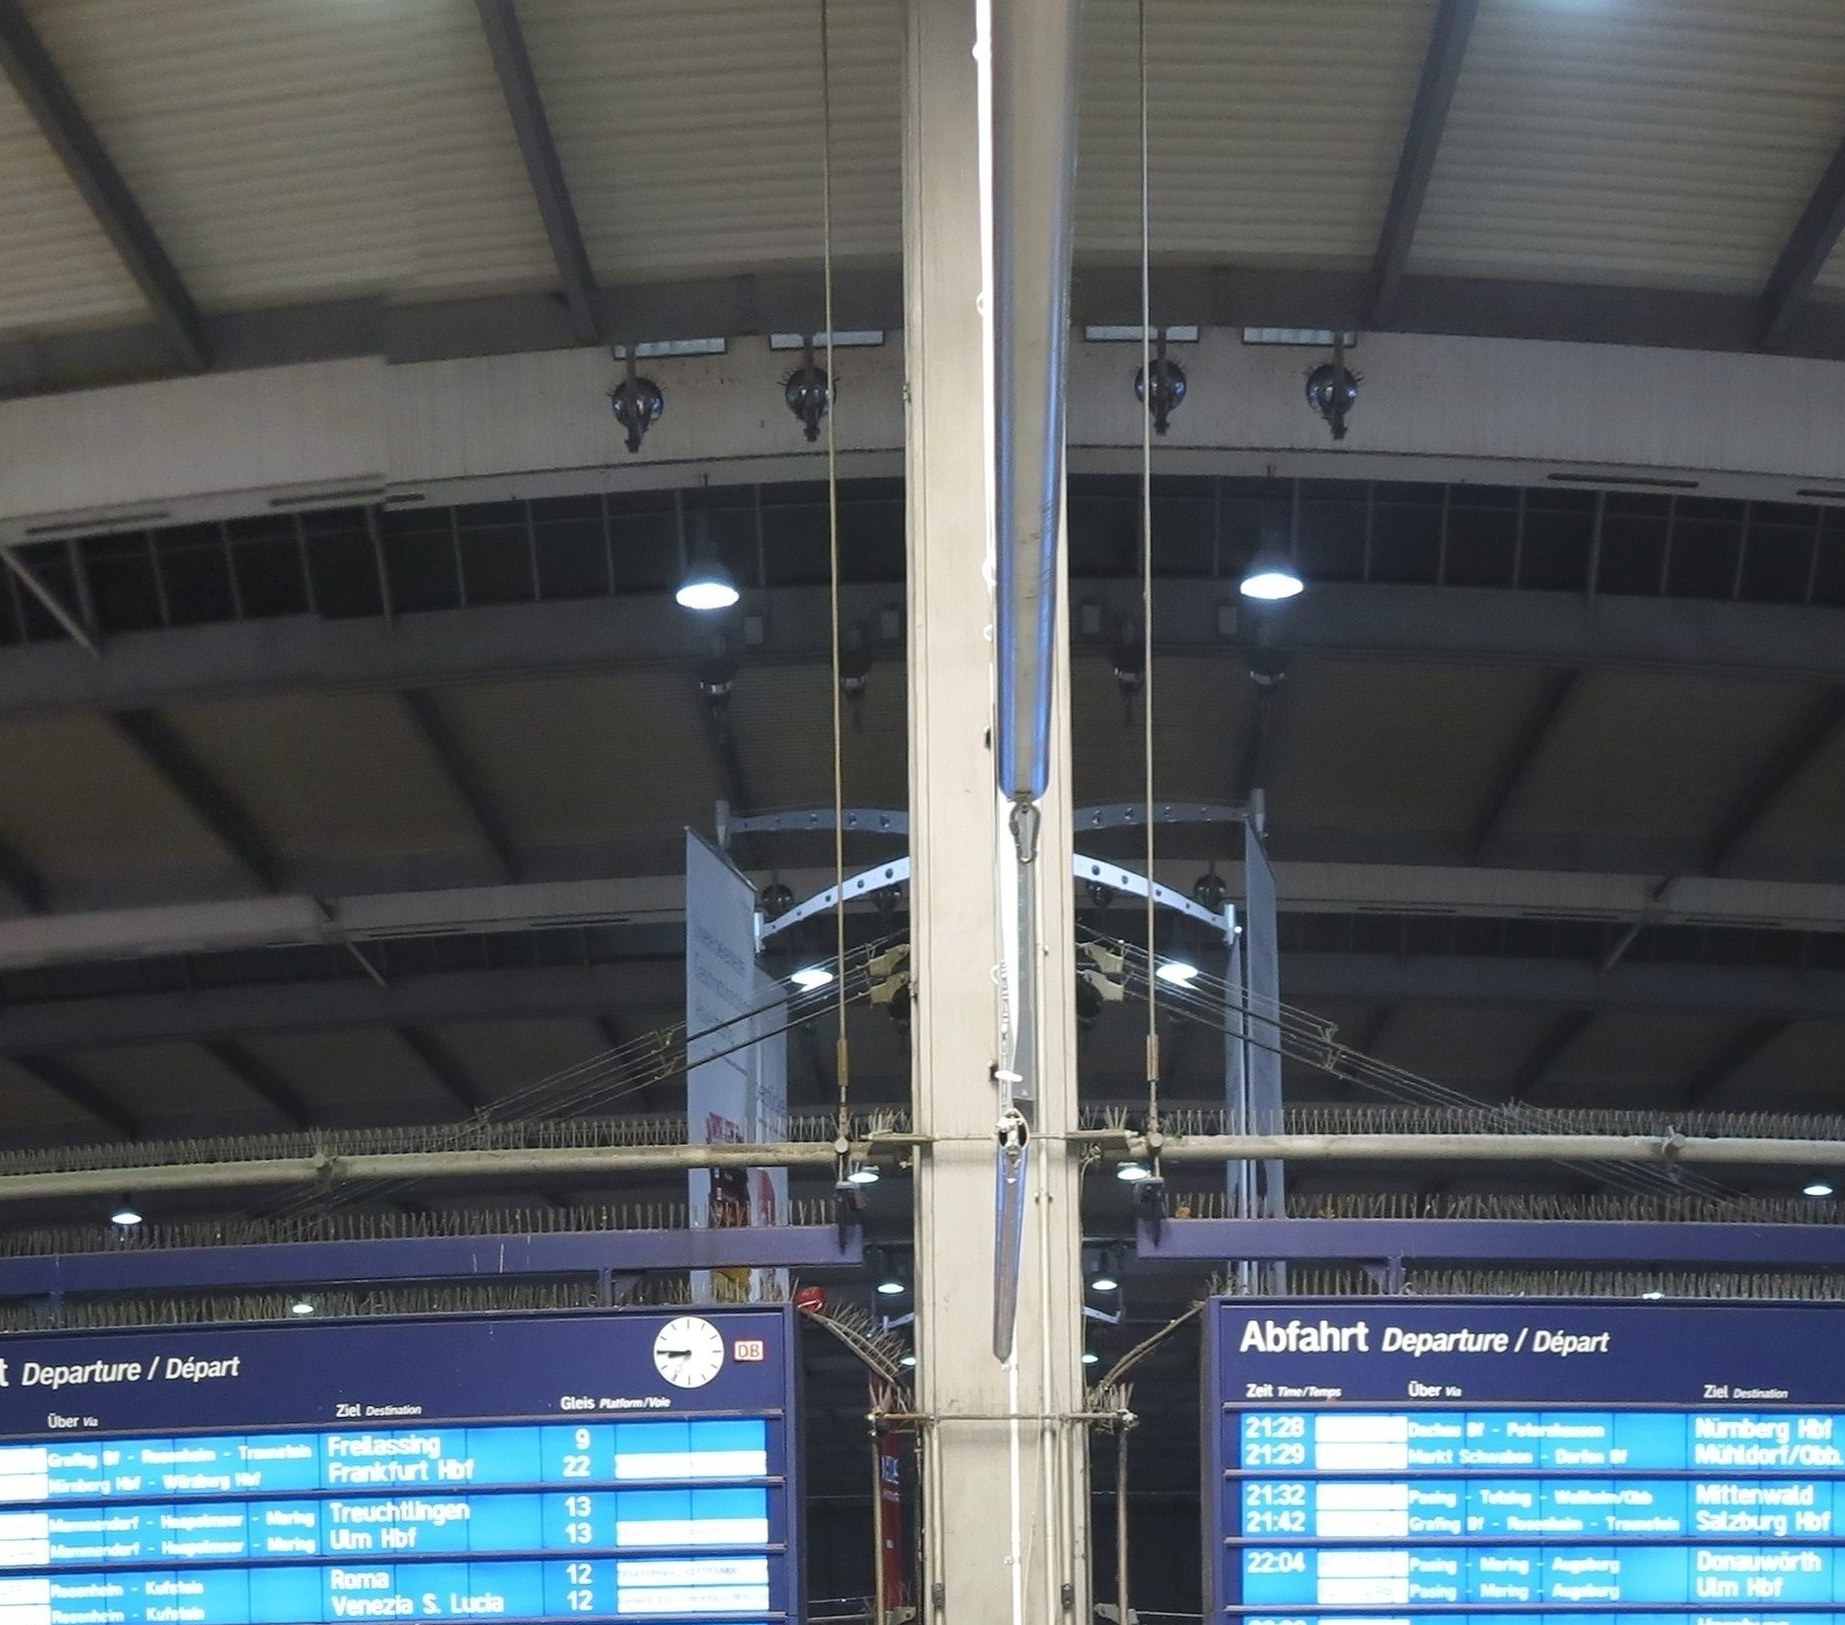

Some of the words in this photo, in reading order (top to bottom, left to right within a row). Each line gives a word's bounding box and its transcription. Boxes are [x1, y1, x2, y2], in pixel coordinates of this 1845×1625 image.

[736, 1342, 762, 1360] DB
[1240, 1319, 1369, 1354] Abfahrt
[1381, 1327, 1509, 1357] Departure
[1532, 1329, 1611, 1356] Départ
[21, 1359, 142, 1389] Departure
[165, 1354, 241, 1382] Départ
[1246, 1384, 1274, 1398] Zeit
[1277, 1385, 1342, 1400] Time/Temps
[1408, 1381, 1441, 1398] Über
[1445, 1385, 1462, 1398] Via
[1703, 1385, 1729, 1400] Ziel
[1733, 1387, 1788, 1400] Destination
[48, 1413, 79, 1429] Über
[83, 1416, 98, 1428] Via
[336, 1403, 361, 1418] Ziel
[366, 1404, 422, 1417] Destination
[561, 1396, 595, 1411] Gleis
[600, 1396, 671, 1411] Platform/Voie
[1245, 1416, 1304, 1439] 21:28
[1695, 1417, 1790, 1443] Nürnberg
[1797, 1418, 1833, 1440] Hbf
[327, 1434, 441, 1459] Freilassing
[575, 1429, 590, 1451] 9
[1245, 1443, 1305, 1465] 21:29
[1695, 1443, 1844, 1467] Mühldorf/Obb.
[328, 1462, 428, 1483] Frankfurt
[437, 1459, 475, 1481] Hbf
[562, 1456, 590, 1478] 22
[1246, 1485, 1306, 1507] 21:32
[1696, 1484, 1814, 1506] Mittenwald
[330, 1501, 470, 1526] Treuchtlingen
[564, 1496, 591, 1518] 13
[1247, 1511, 1306, 1532] 21:42
[1696, 1511, 1787, 1536] Salzburg
[1796, 1510, 1831, 1531] Hbf
[330, 1530, 372, 1551] Ulm
[381, 1527, 417, 1548] Hbf
[564, 1522, 591, 1544] 13
[1247, 1552, 1306, 1574] 22:04
[1697, 1551, 1821, 1572] Donauwörth
[330, 1568, 389, 1590] Roma
[566, 1564, 592, 1585] 12
[1697, 1578, 1739, 1599] Ulm
[1747, 1577, 1782, 1598] Hbf
[332, 1594, 414, 1616] Venezia
[422, 1593, 442, 1615] S.
[451, 1592, 504, 1614] Lucia
[567, 1590, 593, 1611] 12
